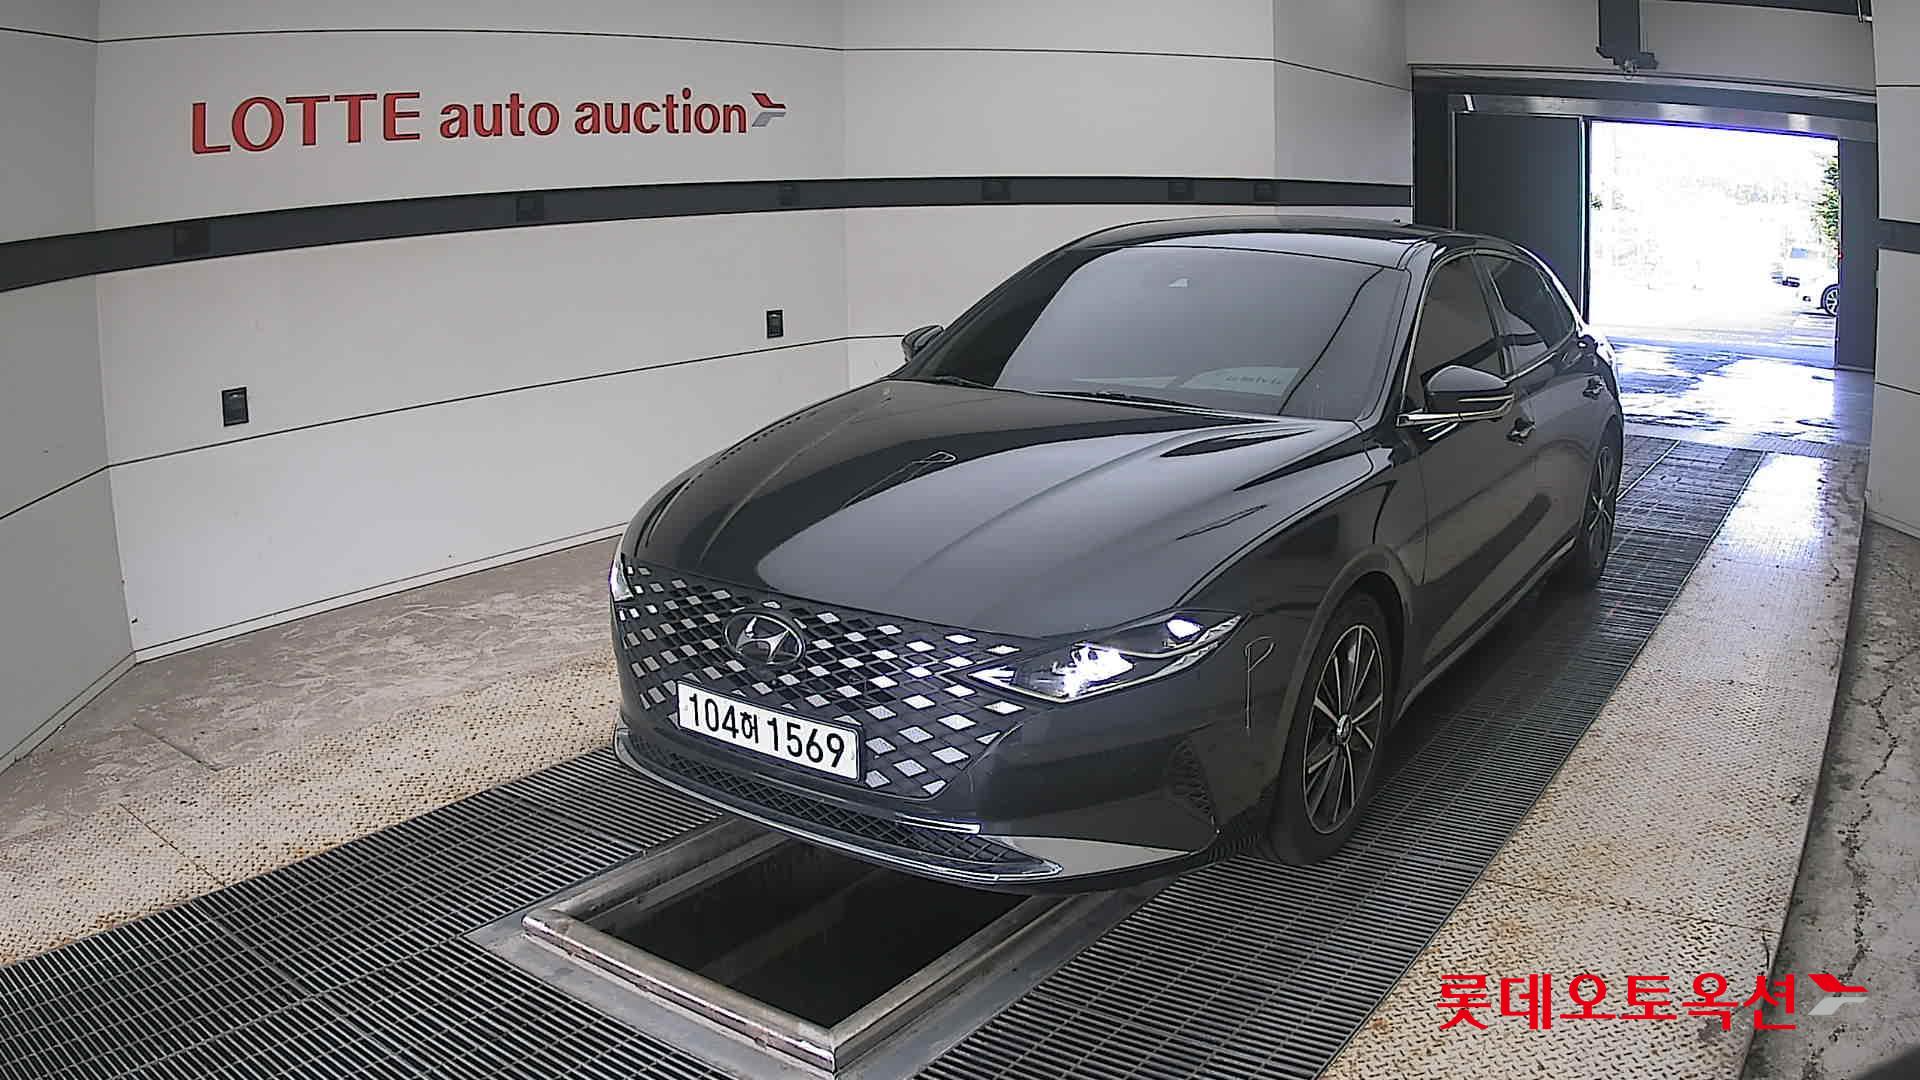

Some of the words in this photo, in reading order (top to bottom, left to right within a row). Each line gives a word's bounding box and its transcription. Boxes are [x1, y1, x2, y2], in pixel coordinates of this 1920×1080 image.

[192, 91, 421, 155] LOTTE
[439, 93, 561, 139] auto
[574, 87, 748, 135] auction
[689, 693, 759, 744] 104허
[767, 717, 845, 768] 1569
